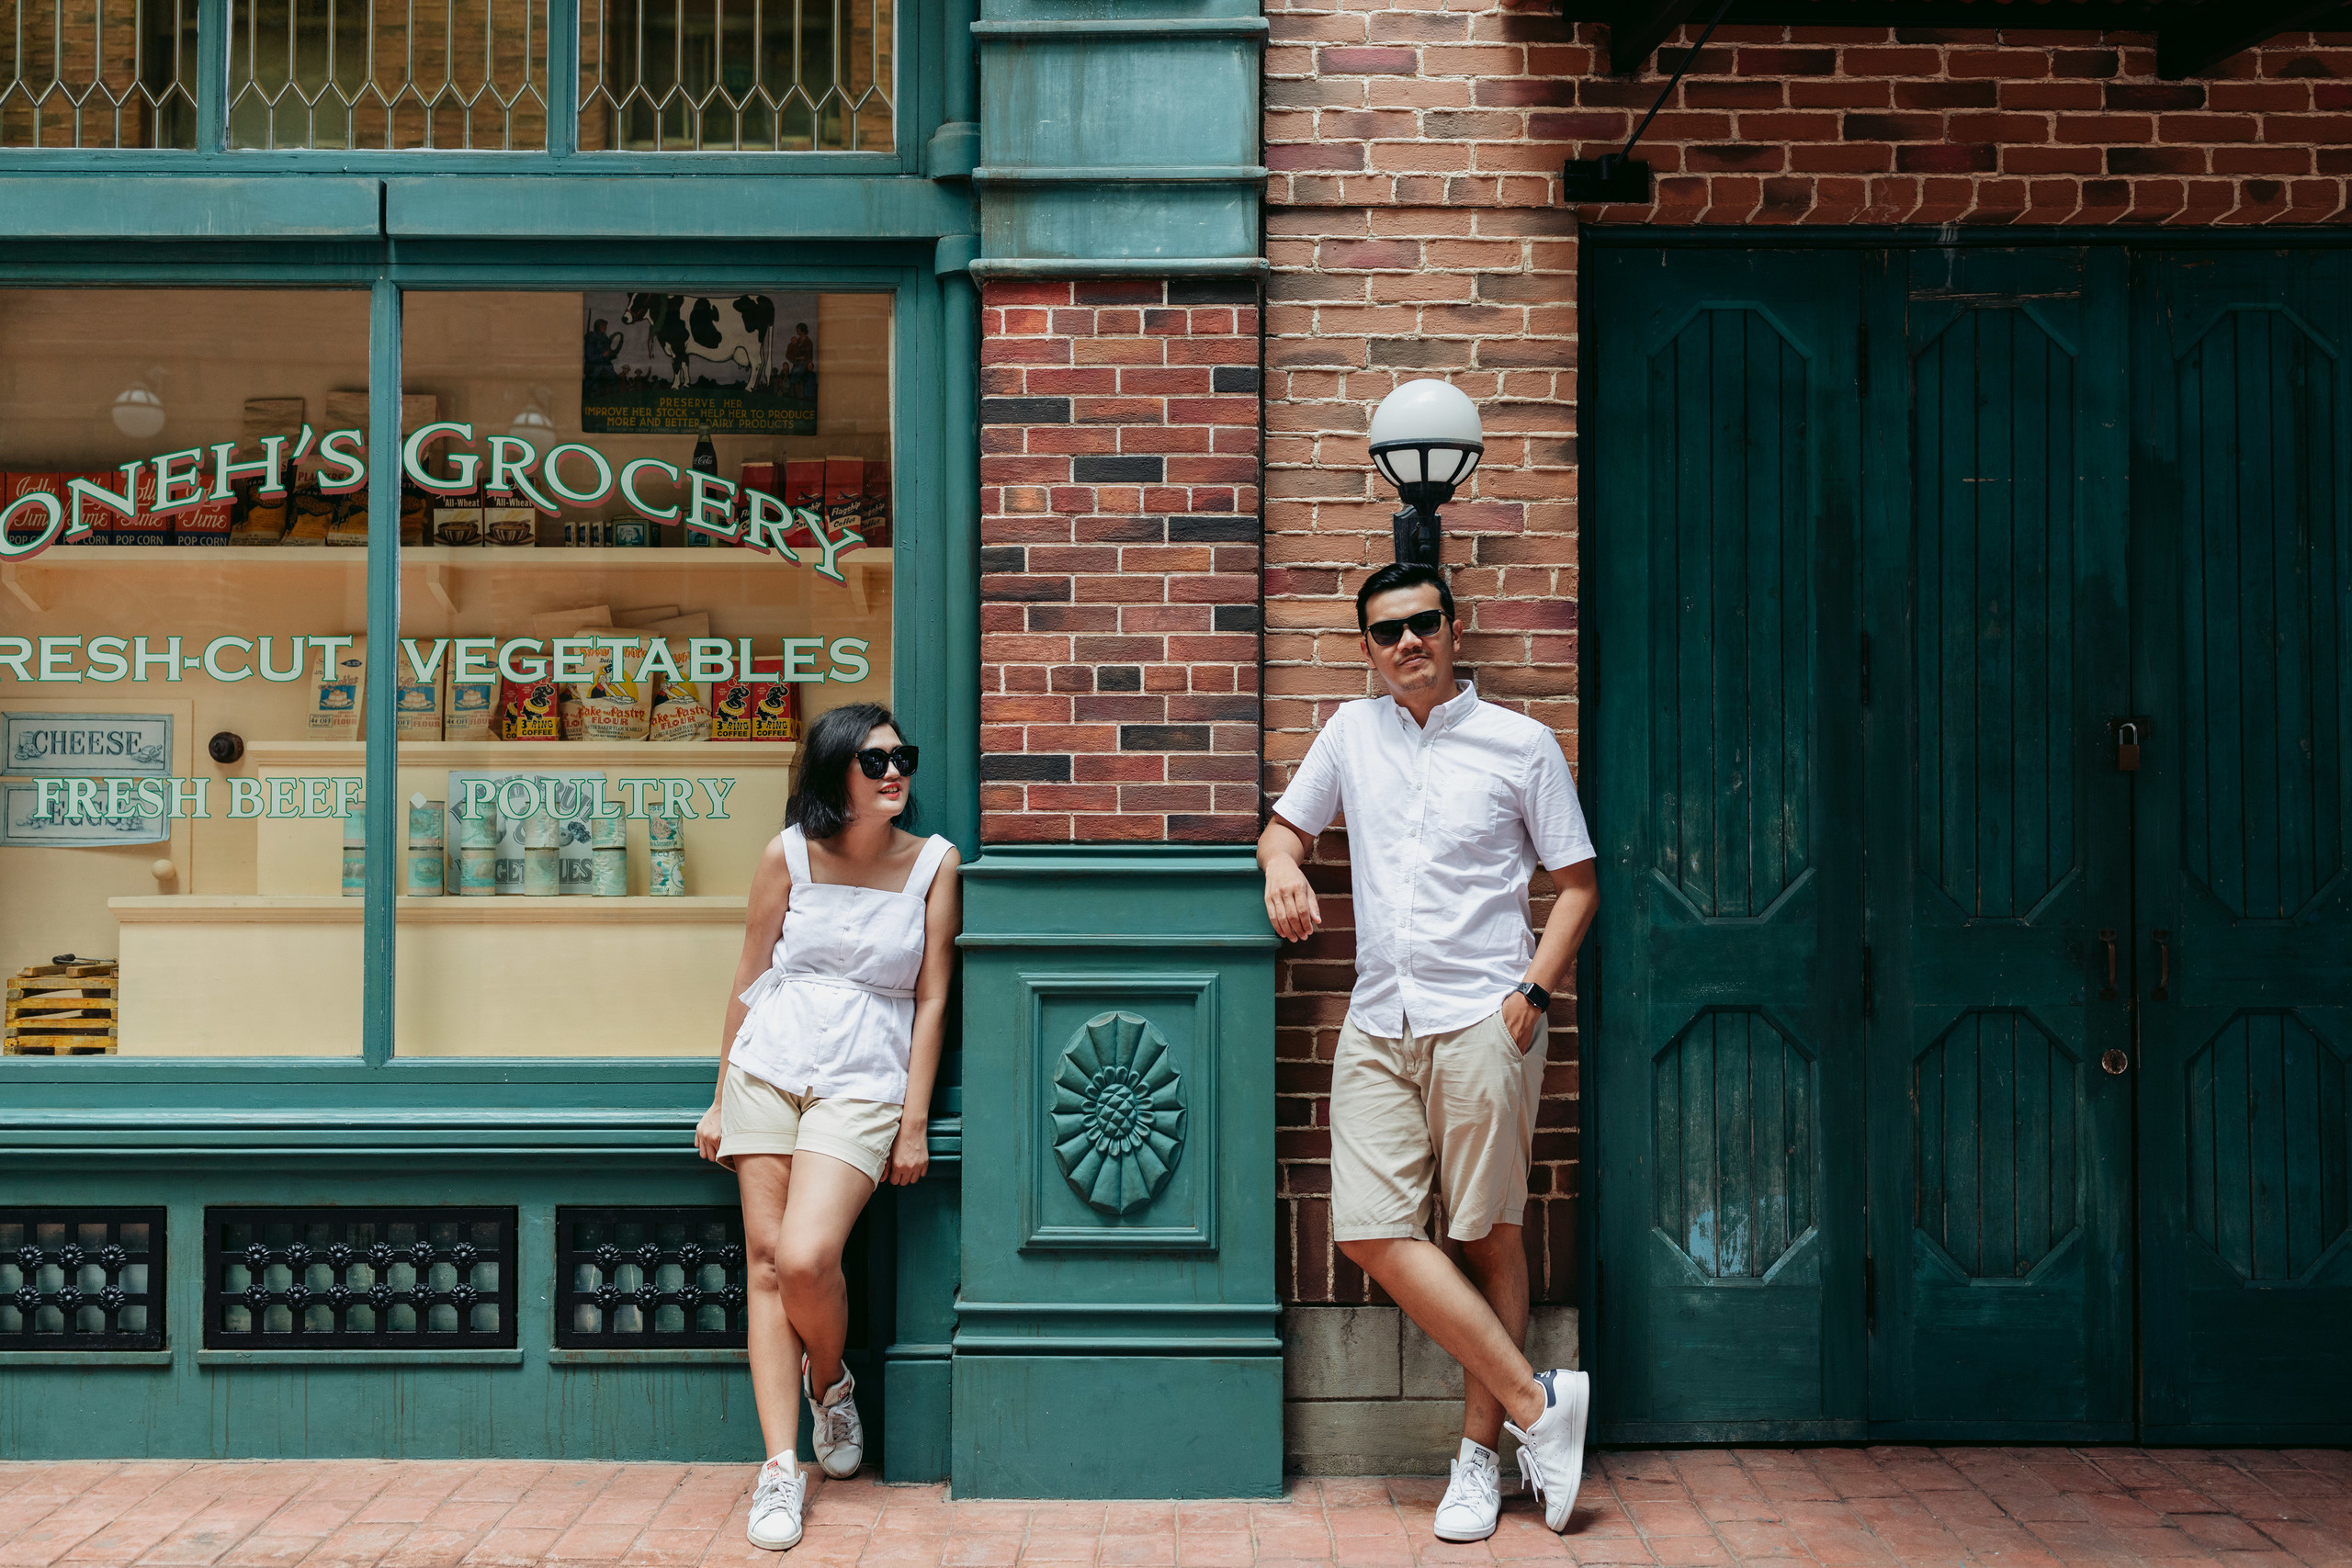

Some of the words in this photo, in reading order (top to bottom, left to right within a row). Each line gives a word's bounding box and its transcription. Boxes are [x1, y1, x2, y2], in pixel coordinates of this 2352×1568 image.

[660, 398, 716, 408] PRESERVE
[723, 399, 743, 409] HER
[584, 406, 629, 417] IMPROVE
[632, 407, 652, 417] HER
[656, 408, 688, 417] STOCK
[700, 409, 725, 418] HELP
[729, 409, 747, 419] HER
[751, 410, 764, 419] TO
[768, 410, 816, 420] PRODUCE
[606, 417, 637, 426] MORE
[639, 418, 662, 427] AND
[665, 418, 700, 427] BETTER
[739, 420, 795, 429] PRODUCTS
[402, 422, 866, 584] GROCERY
[831, 501, 862, 516] Flagship
[833, 516, 856, 528] Coffee
[116, 535, 135, 545] POP
[137, 535, 164, 545] CORN
[177, 536, 198, 546] POP
[199, 536, 228, 547] CORN
[0, 634, 354, 683] RESH-CUT
[399, 636, 870, 684] VEGETABLES
[611, 705, 645, 722] Pastry
[333, 717, 357, 726] FLOUR
[521, 719, 528, 728] 3
[532, 720, 554, 729] RING
[592, 716, 628, 726] FLOUR
[661, 716, 696, 730] FLOUR
[717, 720, 723, 730] 3
[727, 720, 749, 730] RING
[756, 720, 763, 729] 3
[766, 720, 788, 730] RING
[505, 723, 512, 732] 3
[34, 730, 141, 755] CHEESE
[33, 777, 211, 819] FRESH
[227, 777, 363, 819] BEEF
[460, 778, 736, 820] POULTRY
